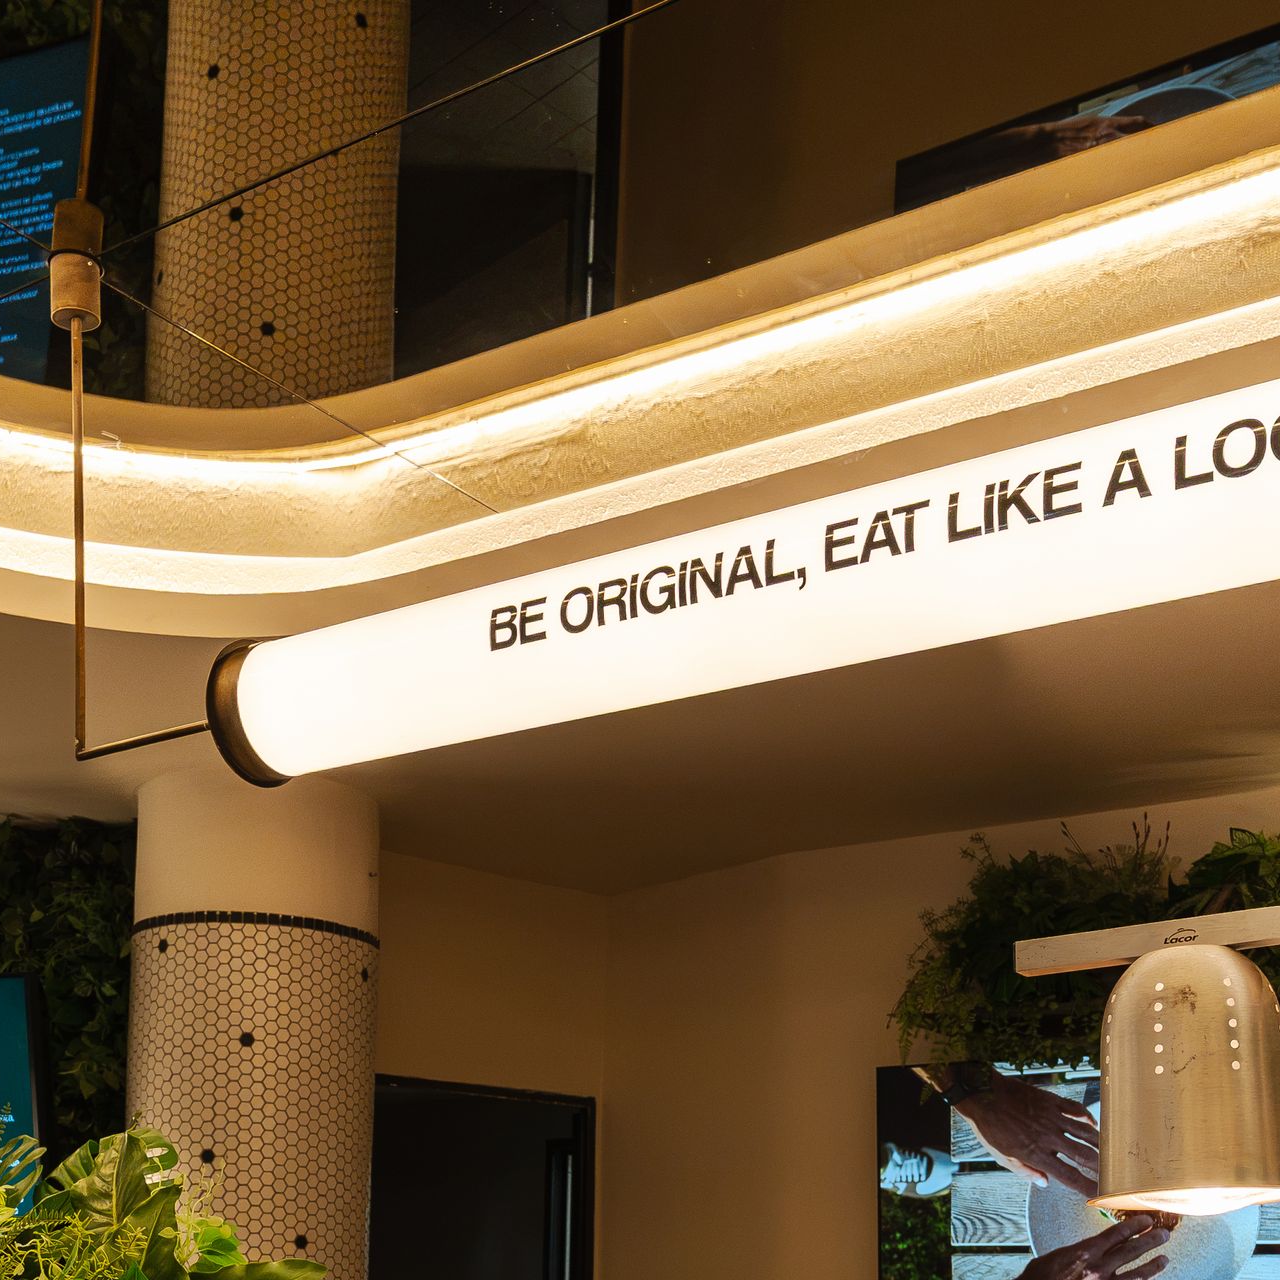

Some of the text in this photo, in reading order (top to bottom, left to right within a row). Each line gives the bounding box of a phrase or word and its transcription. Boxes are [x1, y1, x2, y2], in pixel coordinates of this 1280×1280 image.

[490, 597, 548, 651] BE
[560, 539, 807, 634] ORIGINAL,
[825, 499, 931, 572] EAT
[948, 461, 1083, 542] LIKE
[1102, 448, 1152, 508] A
[1164, 934, 1199, 945] Lacor
